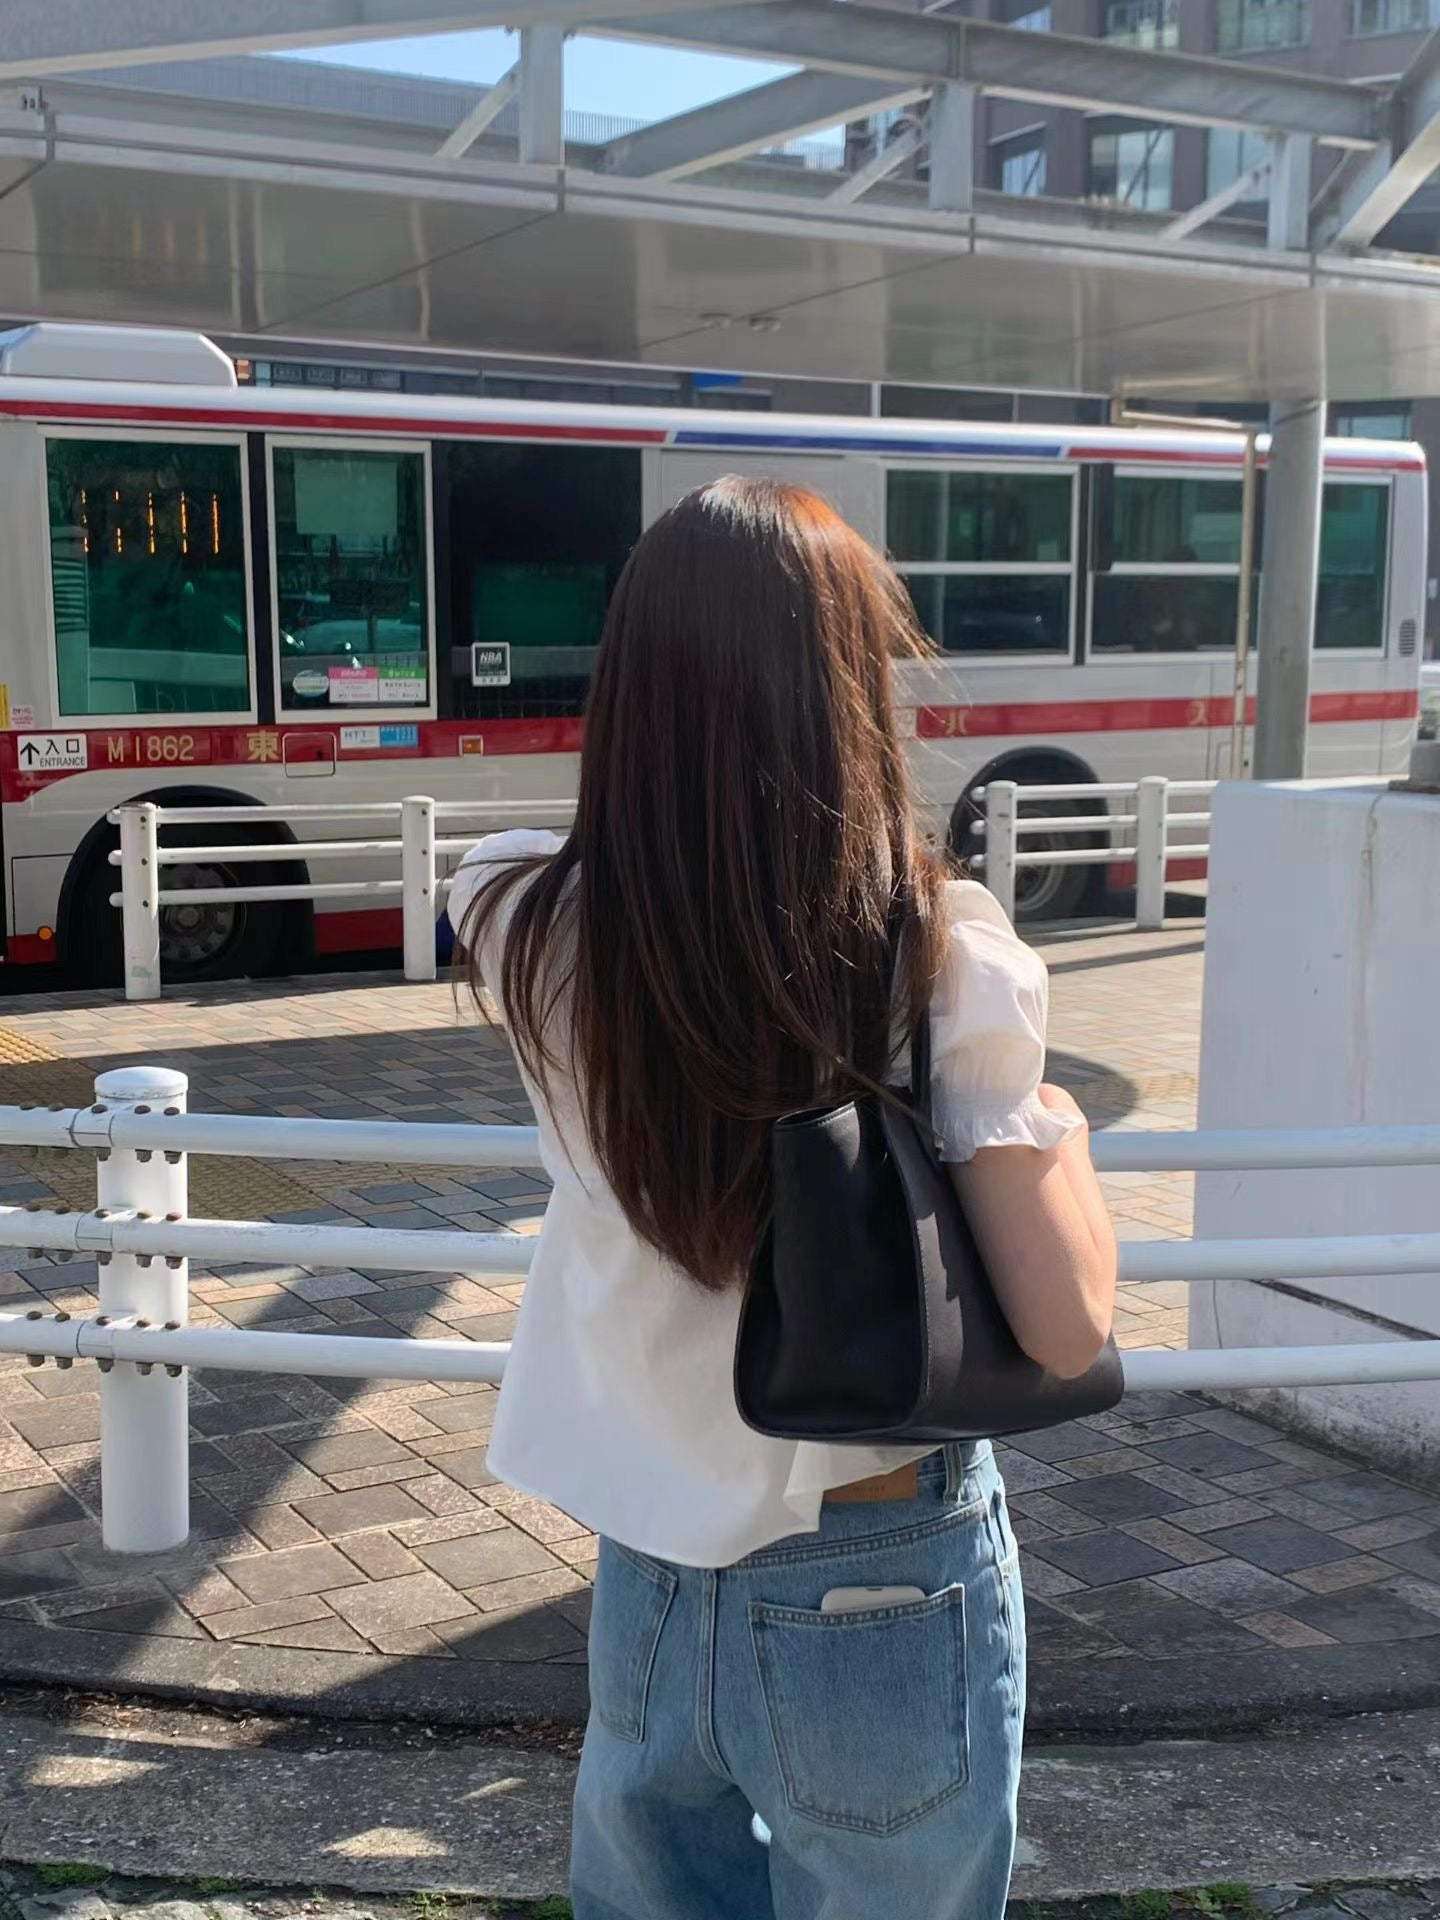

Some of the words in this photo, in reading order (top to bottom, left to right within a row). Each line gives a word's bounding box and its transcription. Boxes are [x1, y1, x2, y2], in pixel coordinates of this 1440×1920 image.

[45, 738, 80, 755] 入口
[246, 729, 280, 762] 東
[39, 756, 86, 768] ENTRANCE
